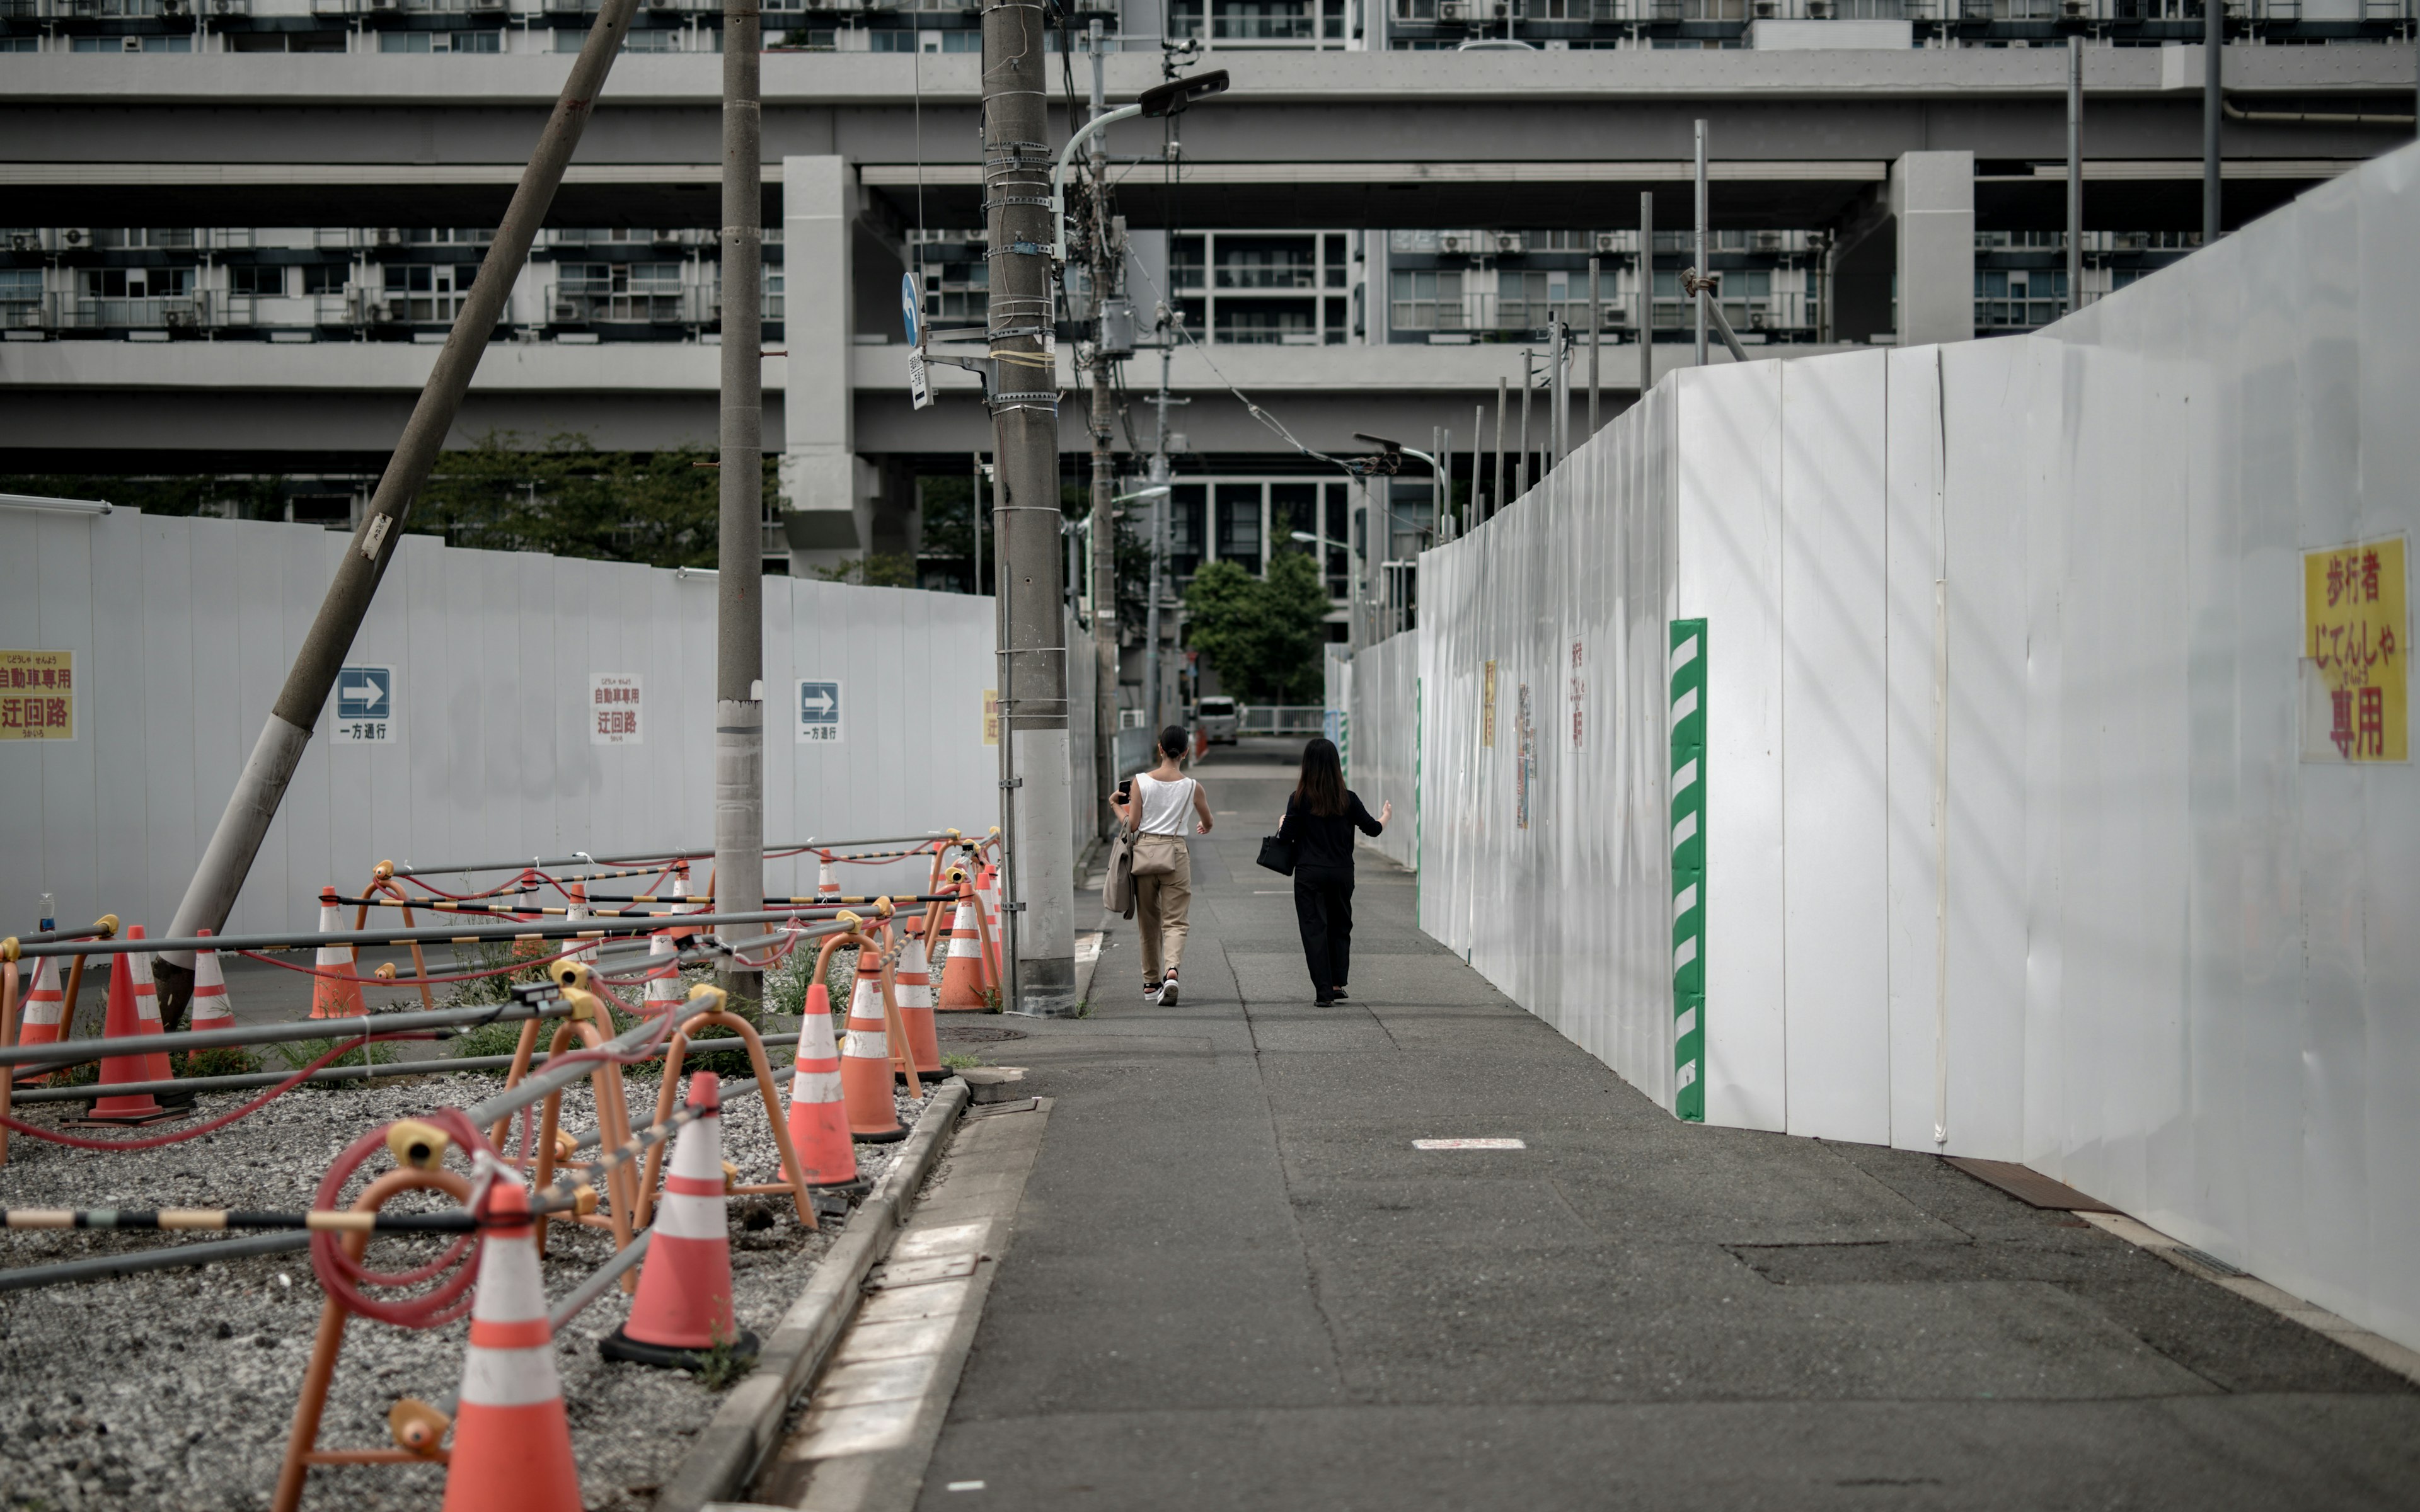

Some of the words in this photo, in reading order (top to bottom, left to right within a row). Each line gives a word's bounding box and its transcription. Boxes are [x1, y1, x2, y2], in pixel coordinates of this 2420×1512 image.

[2326, 549, 2381, 608] 歩行者
[2315, 621, 2395, 669] じてんしゃ
[7, 655, 32, 663] じどうしゃ
[35, 656, 57, 664] せんよう
[0, 667, 71, 689] 自動車専用
[595, 687, 640, 704] 自動車専用
[2, 696, 67, 728] 迂回路
[598, 710, 637, 734] 迂回路
[2331, 684, 2384, 758] 専用
[22, 730, 44, 738] うかいろ
[340, 723, 386, 740] 一方通行
[803, 726, 836, 740] 一方通行
